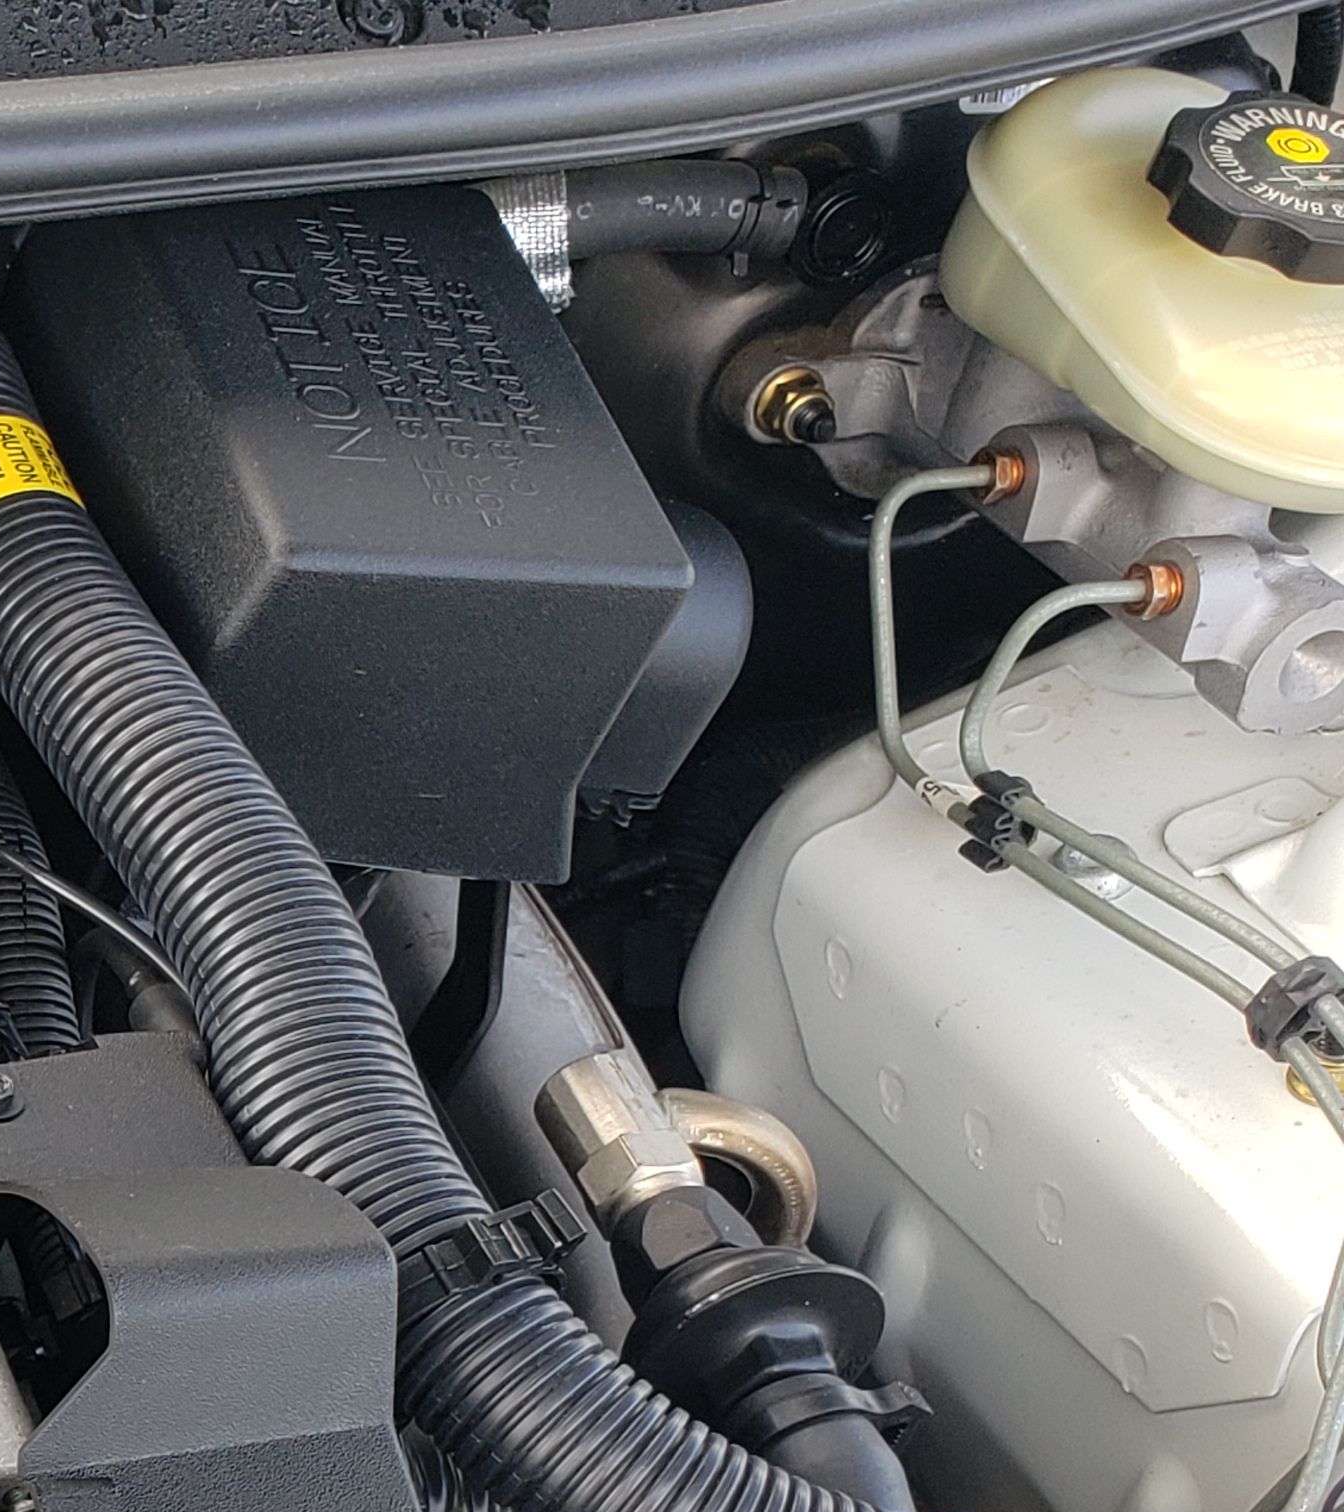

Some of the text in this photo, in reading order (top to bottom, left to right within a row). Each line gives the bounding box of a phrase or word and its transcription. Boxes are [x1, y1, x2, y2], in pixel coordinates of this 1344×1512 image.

[1210, 144, 1254, 184] FLUID
[1248, 181, 1324, 216] BRAKE
[222, 239, 387, 462] NOTICE
[346, 318, 429, 440] SERVICE
[445, 279, 559, 450] PROCEDURES
[402, 340, 481, 461] SPECIAL
[414, 453, 463, 510] SEE
[469, 407, 539, 497] CABLE
[467, 474, 505, 529] FOR
